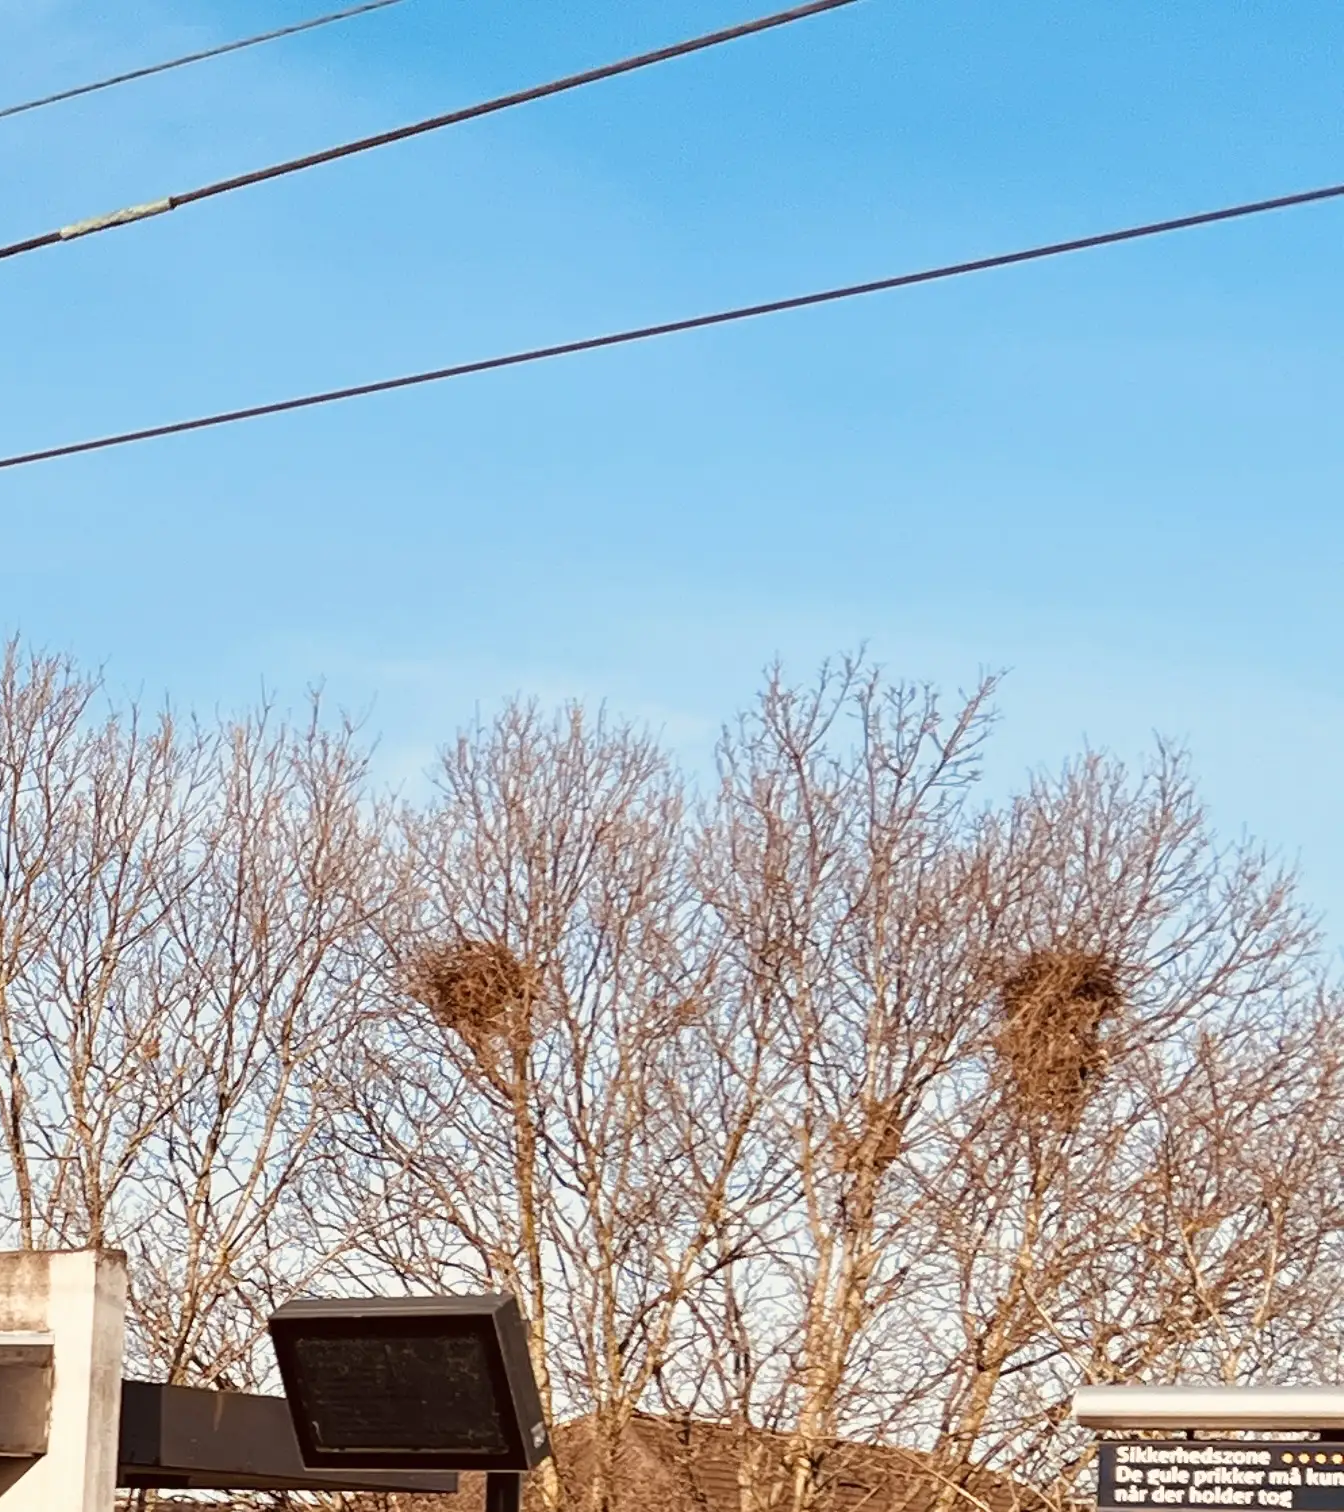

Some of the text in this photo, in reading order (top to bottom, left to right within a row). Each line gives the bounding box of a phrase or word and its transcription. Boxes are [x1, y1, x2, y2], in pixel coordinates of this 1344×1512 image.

[1116, 1446, 1271, 1465] Sikkerhedszone
[1116, 1466, 1344, 1487] De gule prikker må kun
[1114, 1485, 1293, 1509] når der holder tog
